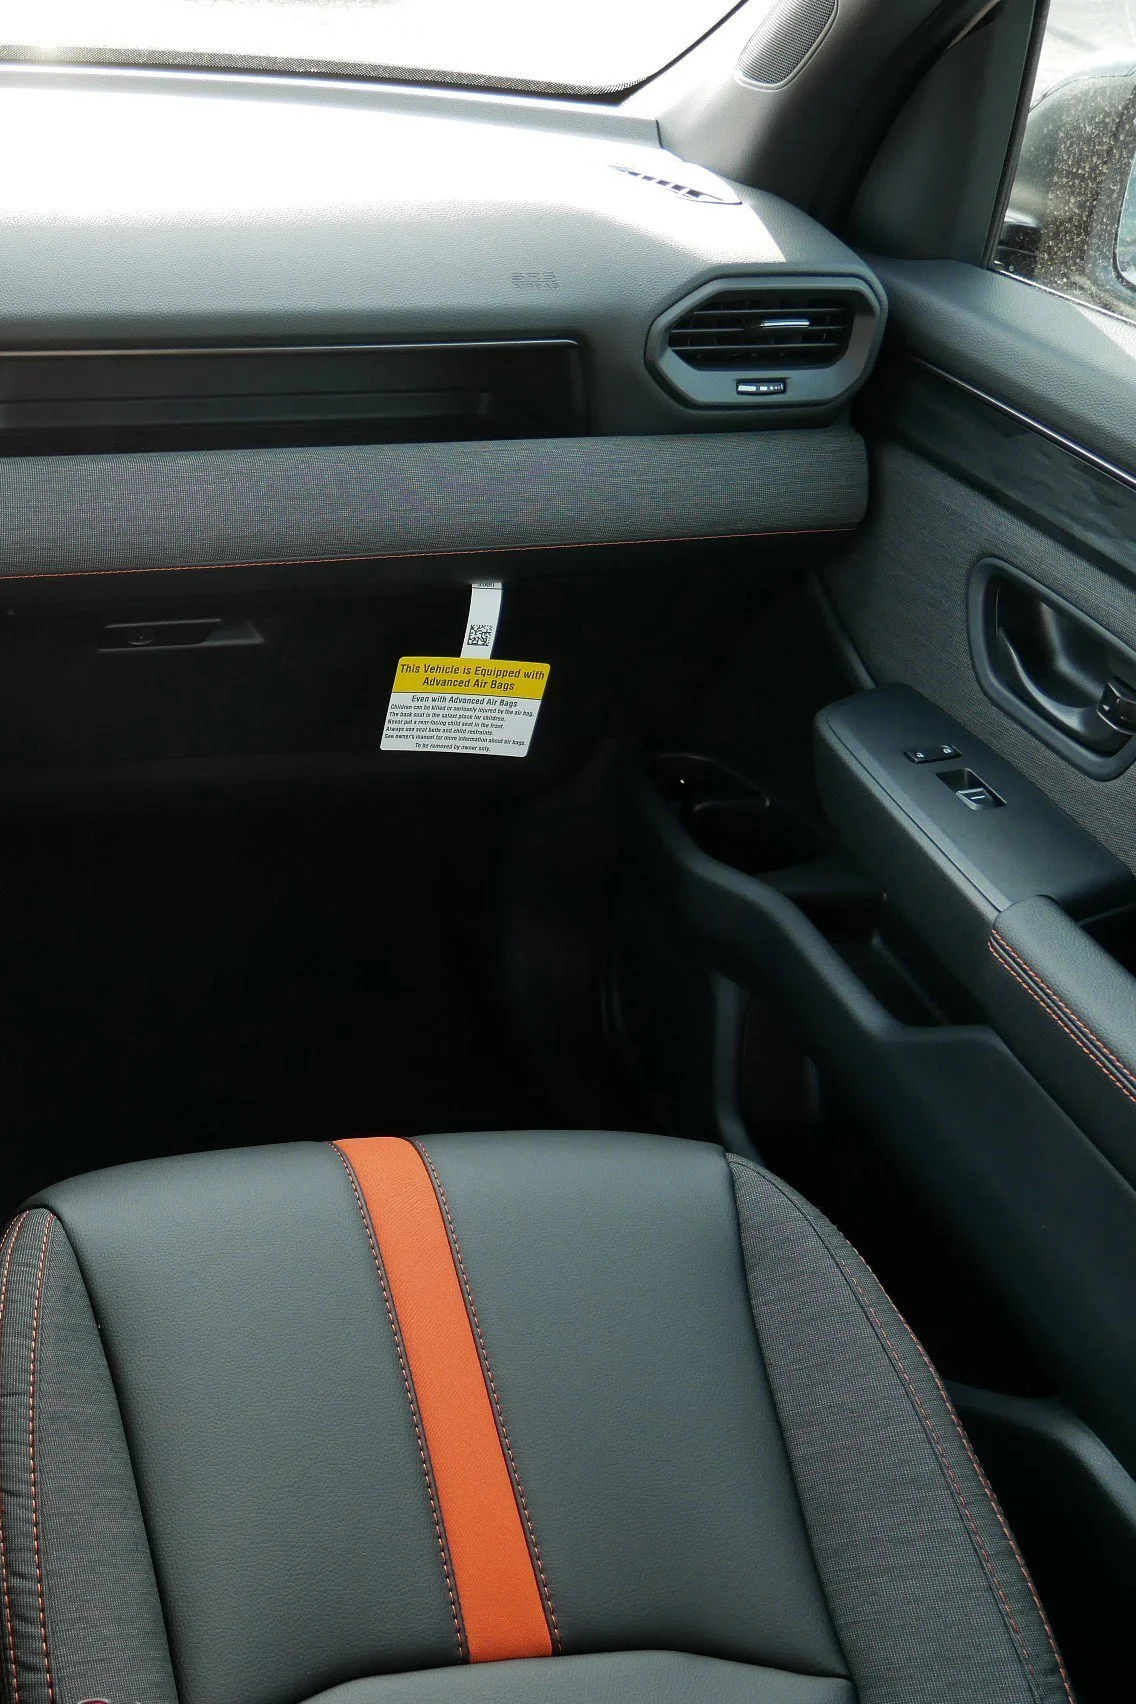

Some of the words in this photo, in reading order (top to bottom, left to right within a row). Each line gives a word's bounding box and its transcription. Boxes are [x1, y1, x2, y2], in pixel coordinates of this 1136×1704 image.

[400, 664, 420, 674] This
[424, 664, 460, 674] Vehicle
[463, 666, 471, 675] is
[474, 666, 521, 678] Equipped
[523, 670, 544, 680] with
[422, 677, 470, 688] Advanced
[473, 679, 488, 688] Air
[490, 680, 515, 691] Bags
[448, 696, 484, 705] Advanced
[500, 699, 518, 708] Bags
